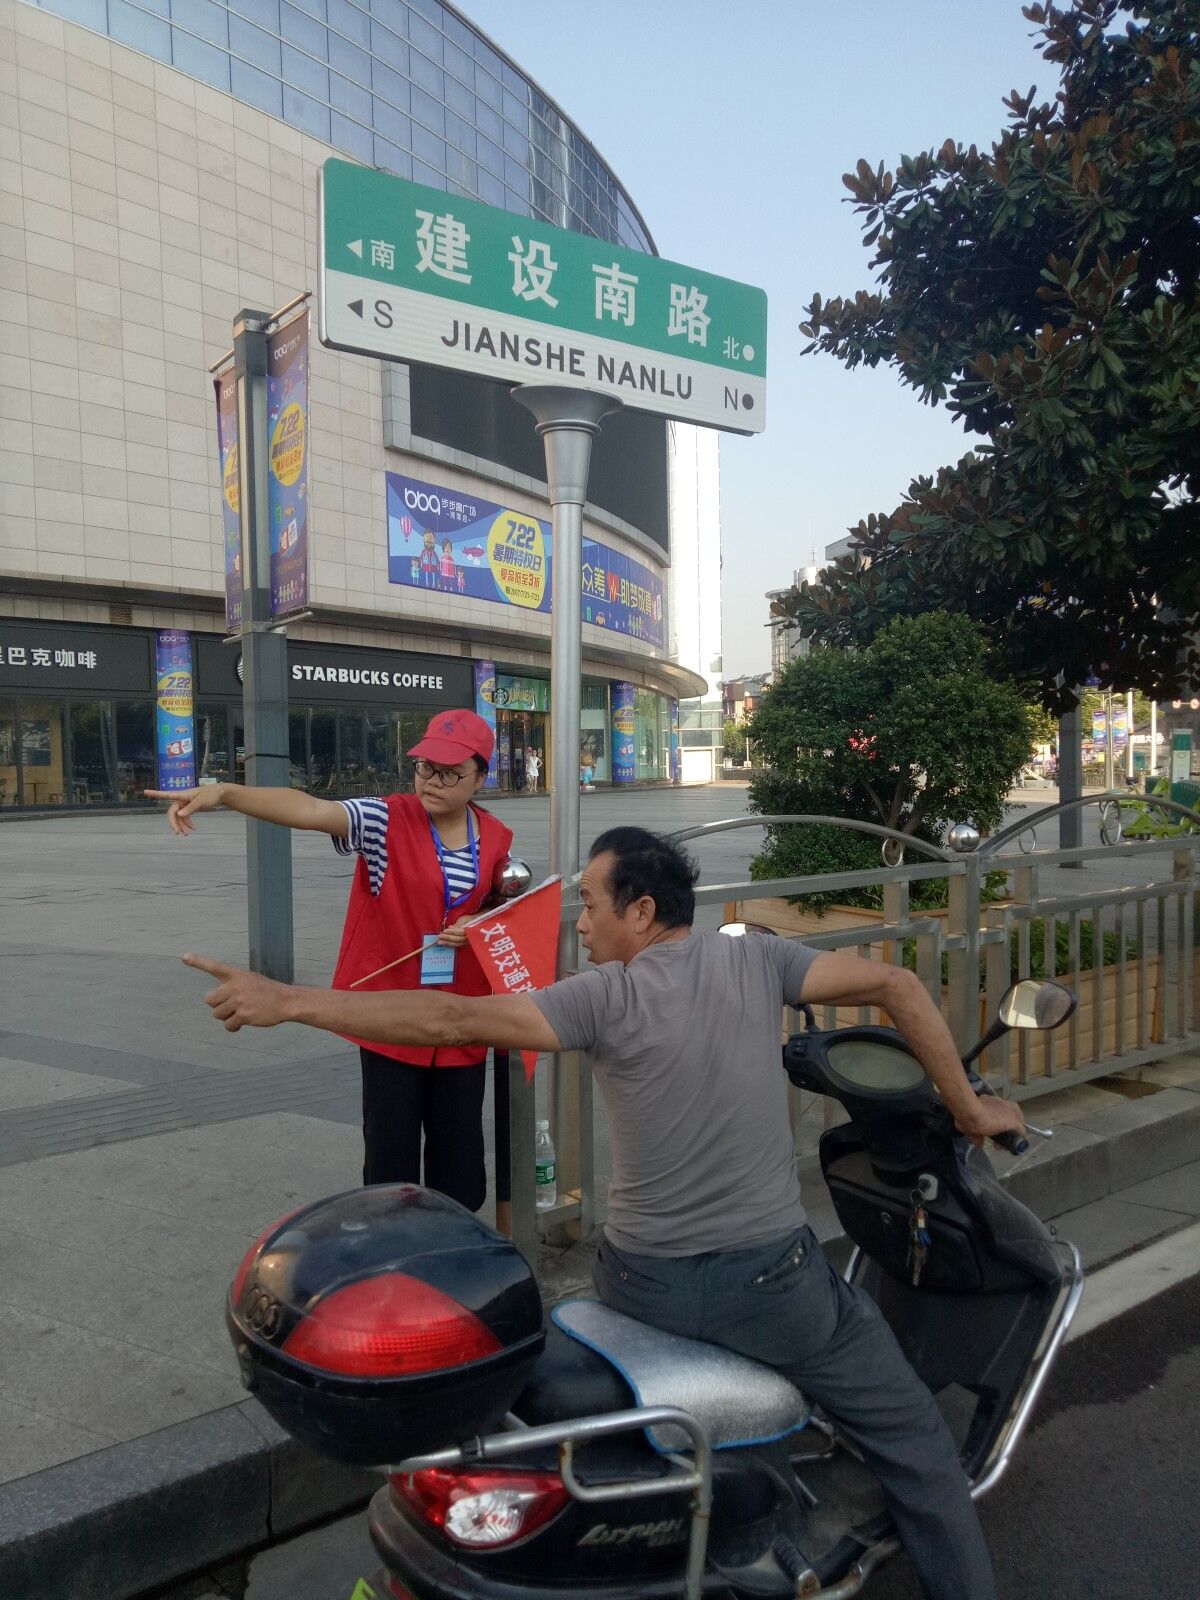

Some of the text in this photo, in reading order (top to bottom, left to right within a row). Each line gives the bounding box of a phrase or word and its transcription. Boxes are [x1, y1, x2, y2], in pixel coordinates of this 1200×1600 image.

[371, 238, 396, 271] 南
[415, 209, 712, 347] 建设南路
[373, 299, 394, 330] S
[440, 319, 693, 400] JIANSHE NANLU
[723, 335, 740, 360] 北
[724, 387, 739, 411] N
[505, 518, 537, 551] 7.22
[292, 664, 443, 690] STARBUCKS COFFEE
